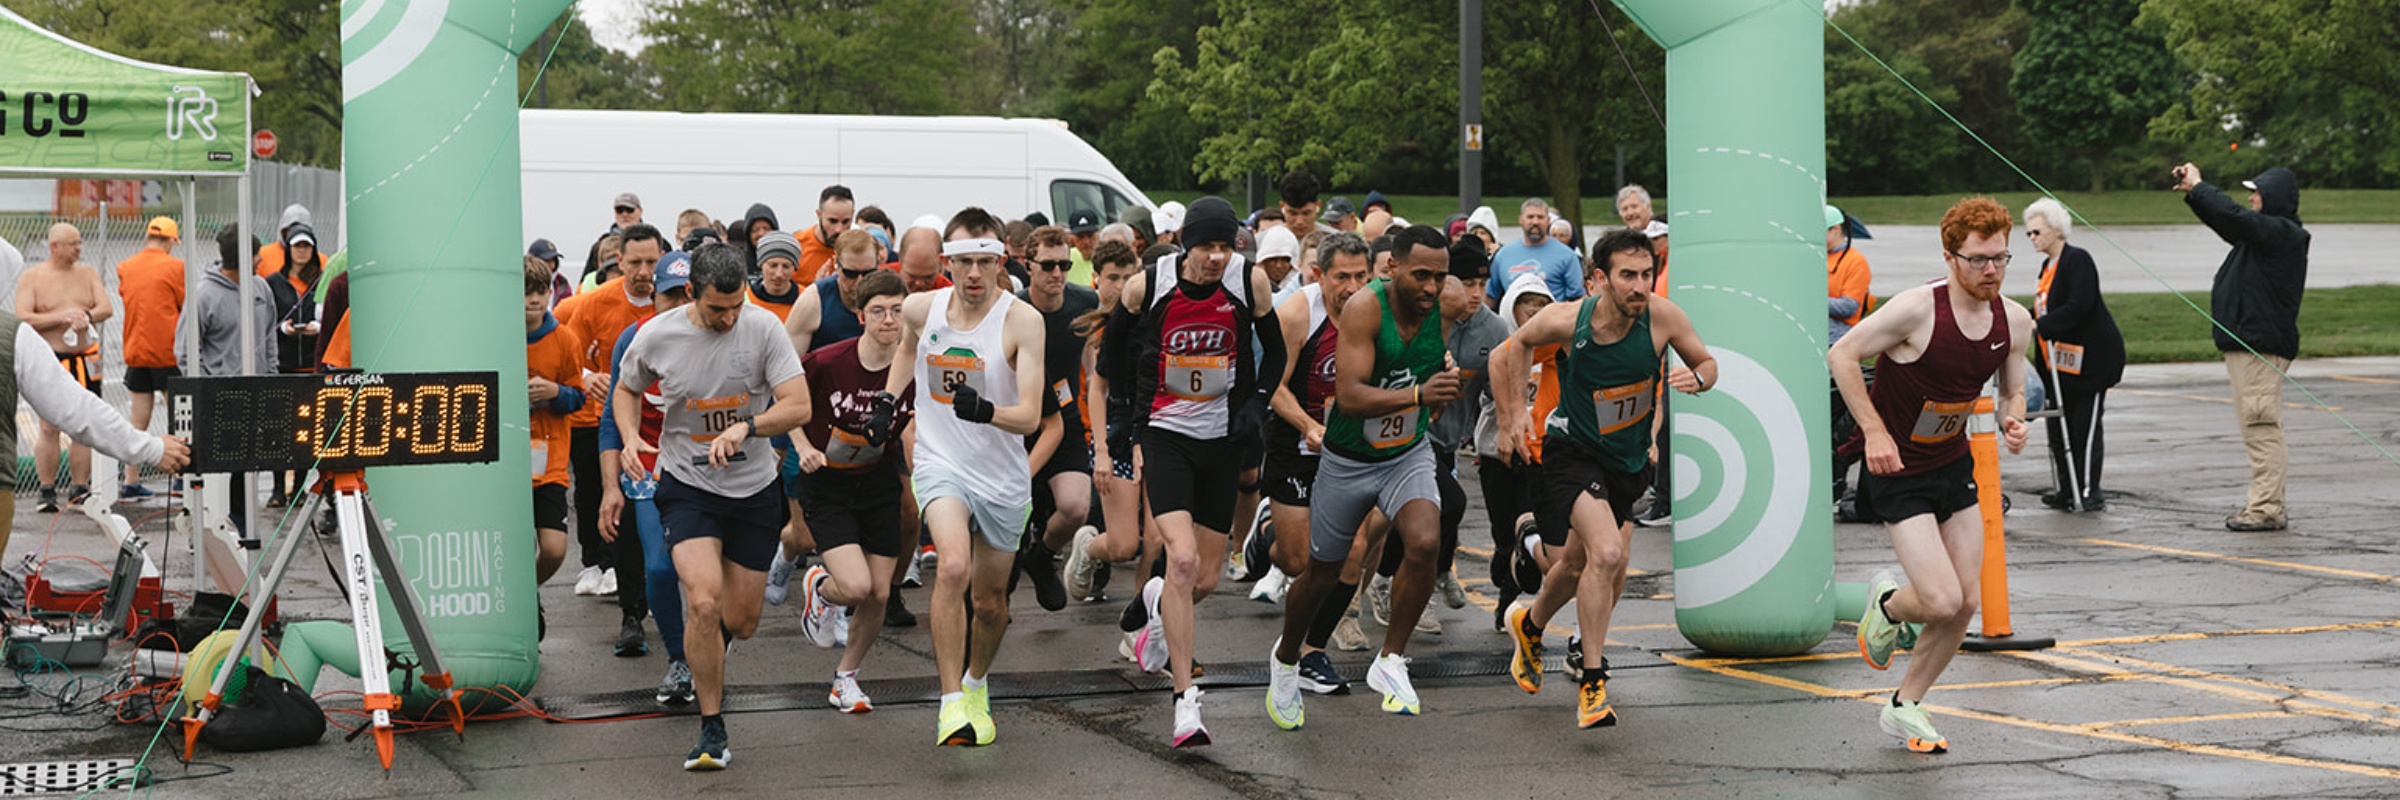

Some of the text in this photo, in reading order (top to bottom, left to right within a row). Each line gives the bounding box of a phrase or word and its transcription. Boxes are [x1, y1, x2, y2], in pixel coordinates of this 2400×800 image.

[1170, 330, 1225, 350] GVH
[1190, 370, 1202, 392] 6
[1613, 396, 1637, 421] 77
[701, 409, 740, 432] 105
[1380, 415, 1404, 438] 29
[1933, 414, 1960, 435] 76
[850, 445, 862, 462] 7
[493, 531, 505, 613] RACING
[430, 592, 490, 617] HOOD
